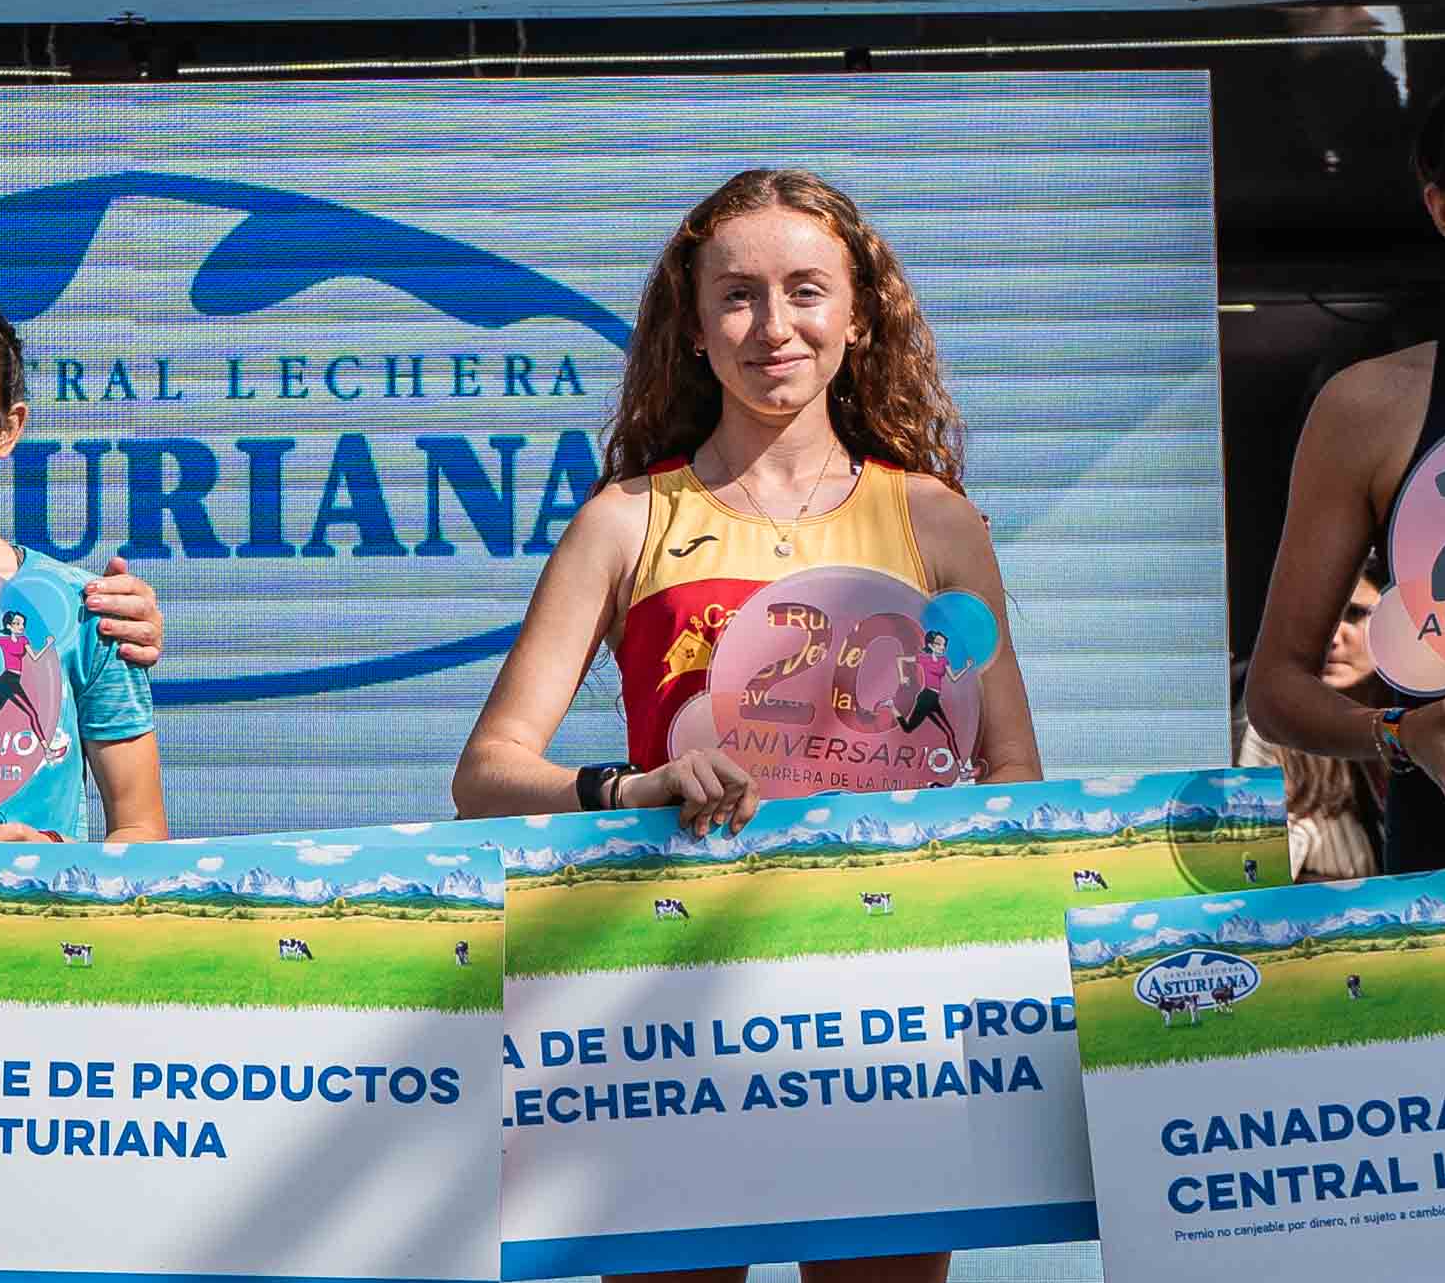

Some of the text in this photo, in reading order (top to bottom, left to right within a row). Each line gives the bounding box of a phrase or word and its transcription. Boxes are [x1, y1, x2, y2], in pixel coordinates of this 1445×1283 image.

[228, 354, 585, 400] LECHERA
[13, 430, 600, 562] URIANA
[718, 728, 954, 774] ANIVERSARIO
[830, 771, 849, 788] DE
[856, 774, 879, 790] LA
[1148, 972, 1249, 997] ASTURIANA
[540, 1026, 608, 1069] DE
[622, 1021, 695, 1062] UN
[713, 1012, 844, 1056] LOTE
[860, 1004, 927, 1046] DE
[48, 1061, 114, 1100] DE
[132, 1062, 461, 1105] PRODUCTOS
[503, 1055, 1042, 1128] ECHERA ASTURIANA
[1167, 1155, 1418, 1215] CENTRAL
[1174, 1228, 1215, 1242] Premio
[1217, 1227, 1231, 1237] no
[1234, 1221, 1285, 1238] canjeable
[1288, 1220, 1307, 1234] por
[1309, 1215, 1348, 1230] dinero,
[1363, 1210, 1398, 1227] sujeto
